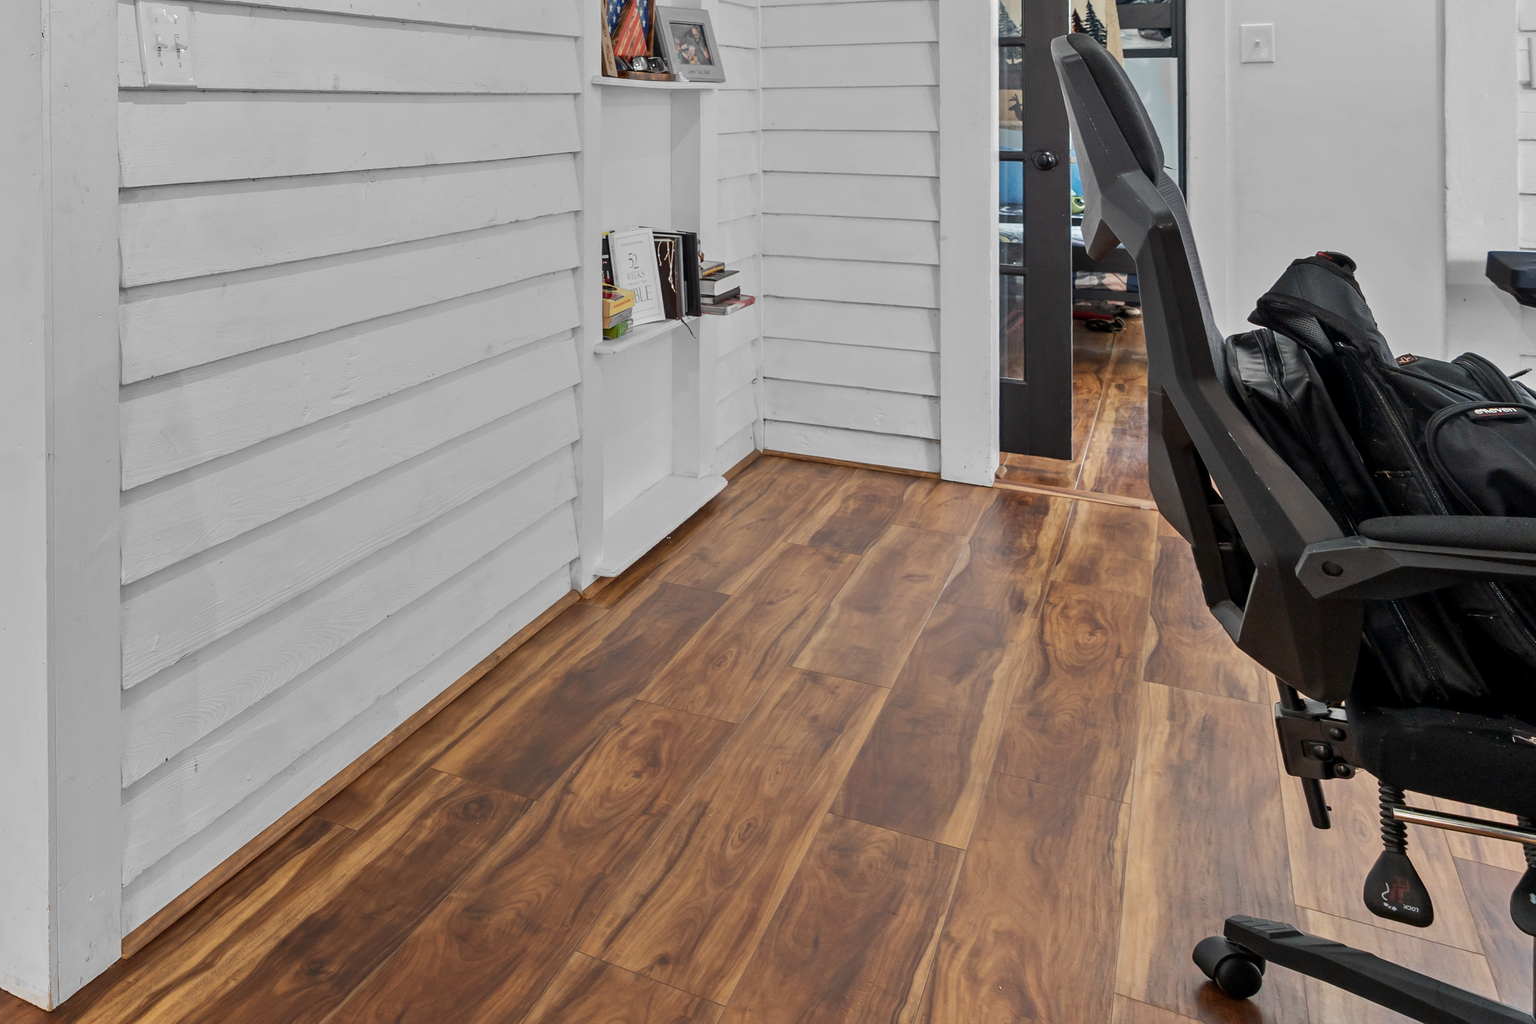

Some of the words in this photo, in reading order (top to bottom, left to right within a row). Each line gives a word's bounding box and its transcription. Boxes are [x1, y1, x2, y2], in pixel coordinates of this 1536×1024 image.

[628, 252, 639, 269] 52
[626, 269, 645, 281] WEEKS
[631, 285, 654, 304] BLE
[1403, 903, 1420, 913] LOCK
